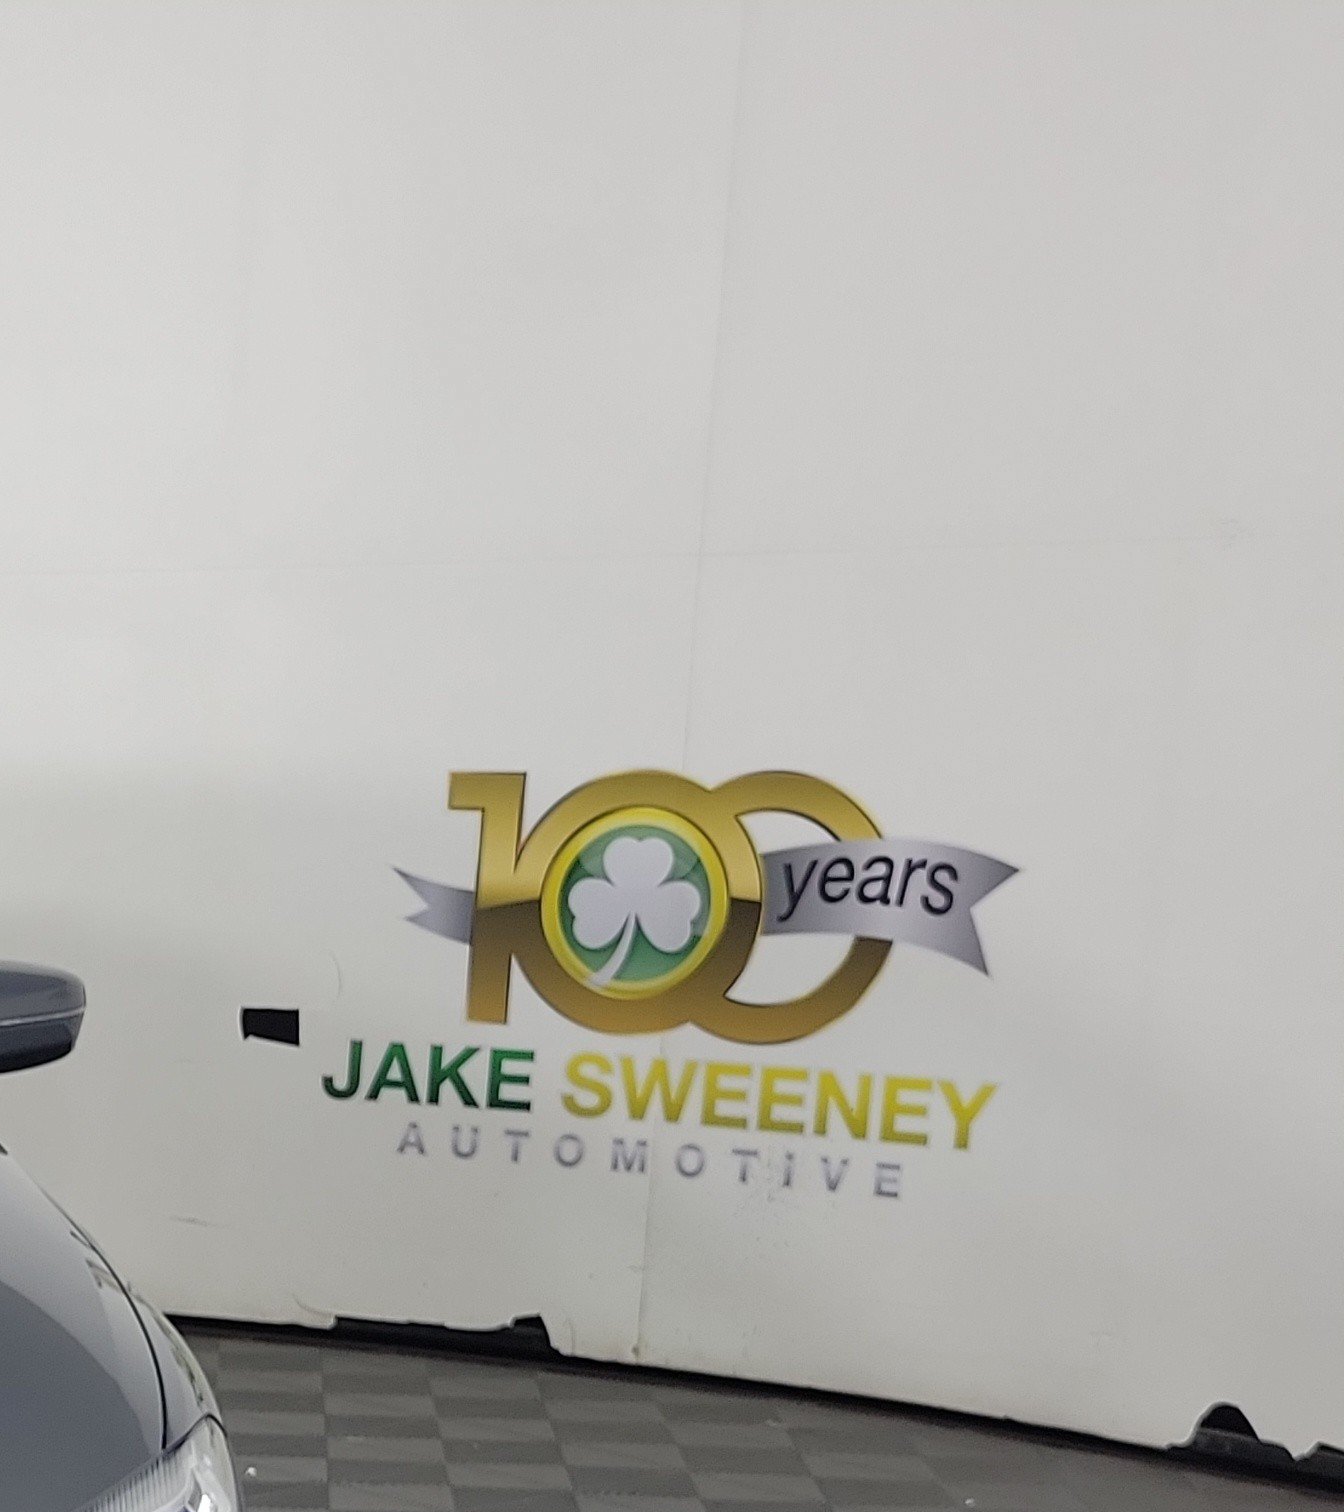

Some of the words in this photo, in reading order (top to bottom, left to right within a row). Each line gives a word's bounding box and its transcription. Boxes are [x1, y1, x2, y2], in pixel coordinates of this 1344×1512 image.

[776, 853, 961, 923] years
[320, 1039, 536, 1113] JAKE
[560, 1051, 998, 1151] SWEENEY
[395, 1120, 903, 1201] AUTOMOTIVE
